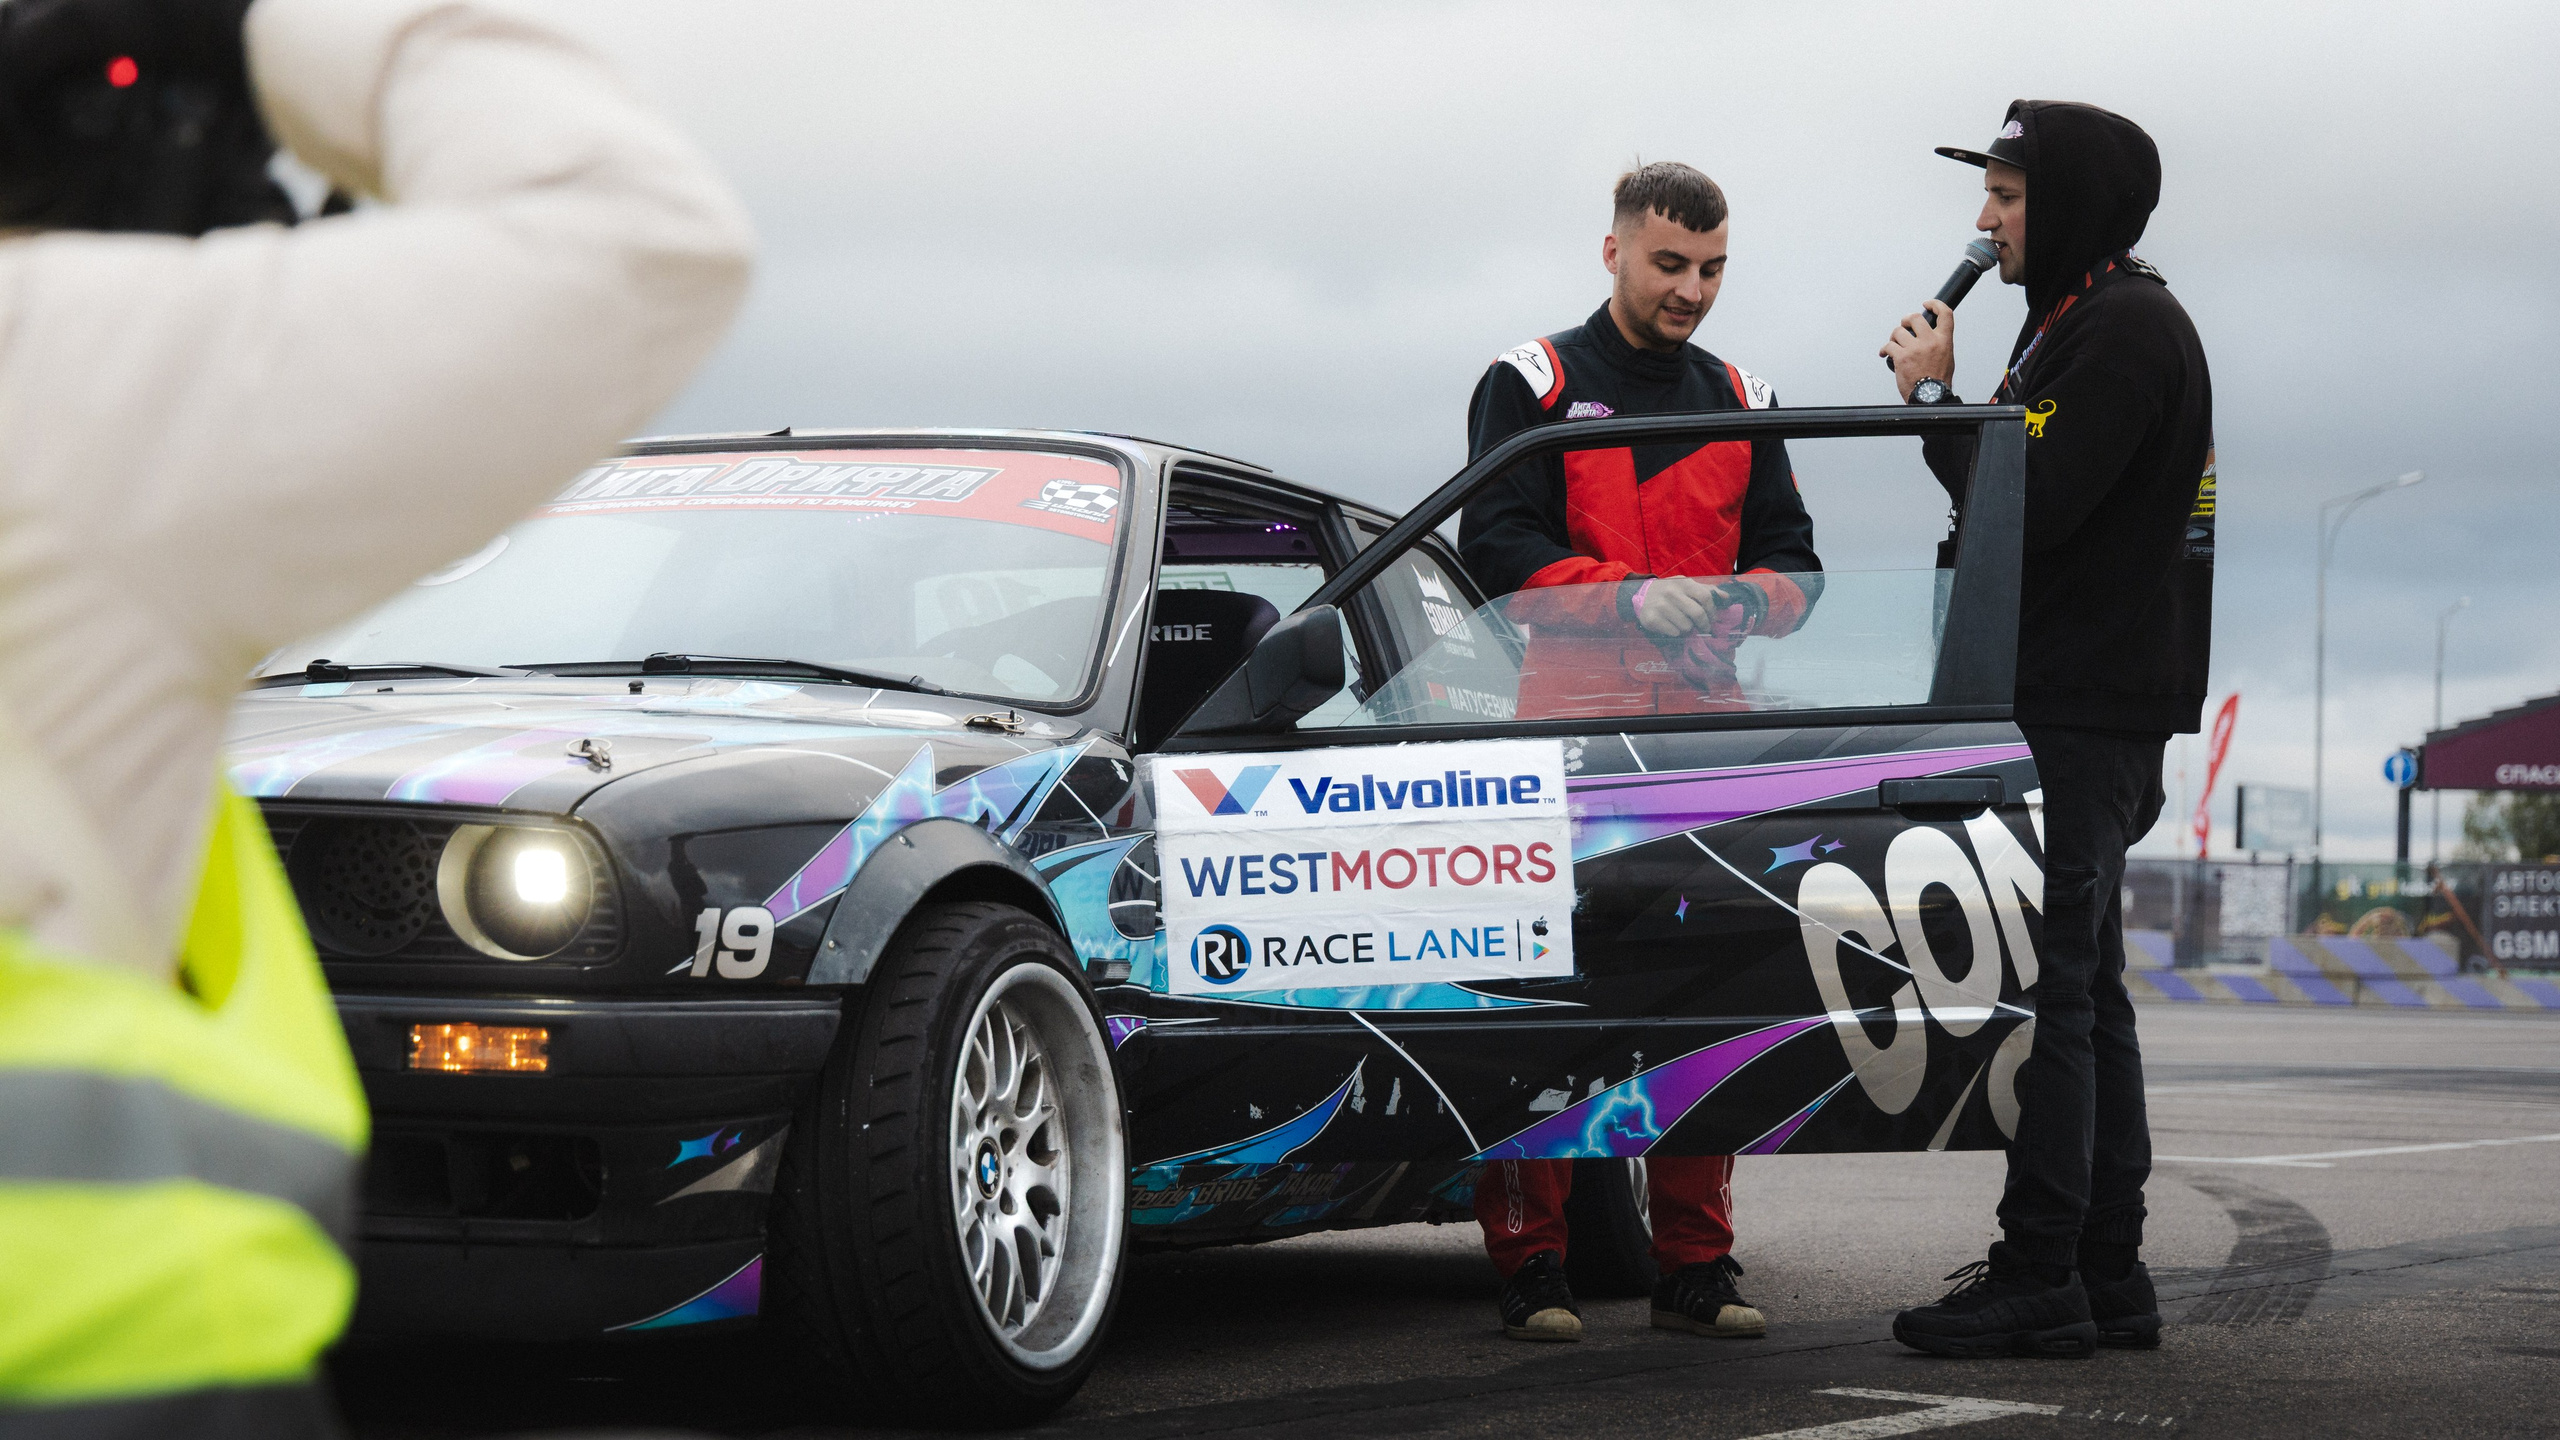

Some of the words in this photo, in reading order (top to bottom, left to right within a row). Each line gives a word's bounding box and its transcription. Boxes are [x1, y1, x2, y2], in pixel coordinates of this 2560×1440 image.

[1421, 600, 1475, 643] GORILLA
[1446, 685, 1517, 719] МАТУСЕВИЧ
[1288, 770, 1541, 814] Valvoline
[2495, 764, 2560, 785] СПАС
[1180, 841, 1557, 897] WESTMOTORS
[690, 906, 775, 979] 19
[1196, 932, 1250, 977] RL
[1263, 932, 1375, 968] RACE
[1388, 926, 1506, 962] LANE
[1193, 1178, 1268, 1205] BRIDE
